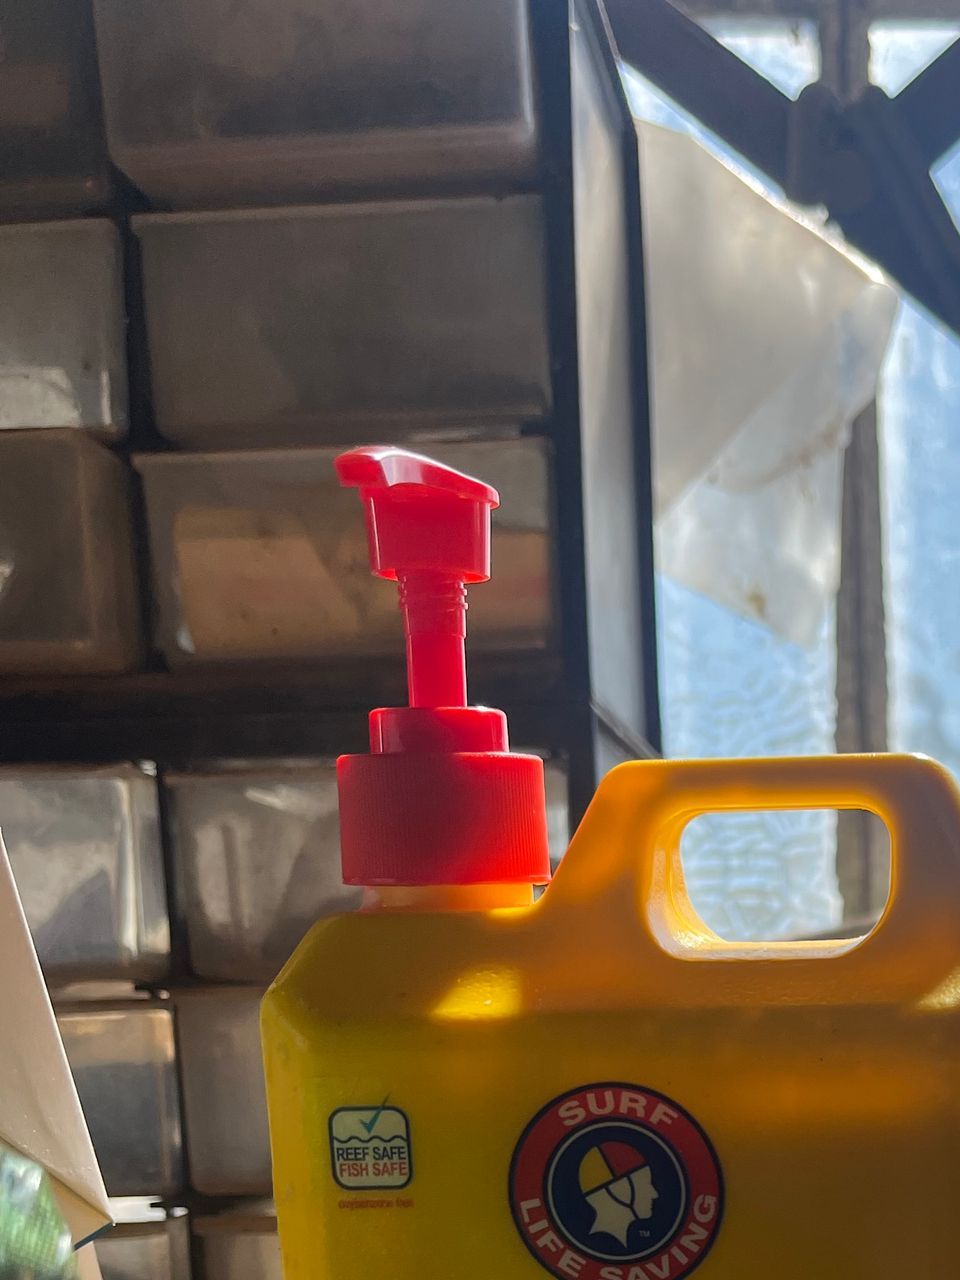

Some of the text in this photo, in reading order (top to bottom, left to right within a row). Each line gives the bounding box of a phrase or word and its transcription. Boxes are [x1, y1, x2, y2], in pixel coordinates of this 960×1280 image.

[557, 1090, 678, 1127] SURF
[336, 1146, 406, 1161] REEF SAFE
[340, 1162, 407, 1178] FISH SAFE
[520, 1198, 586, 1278] LIFE
